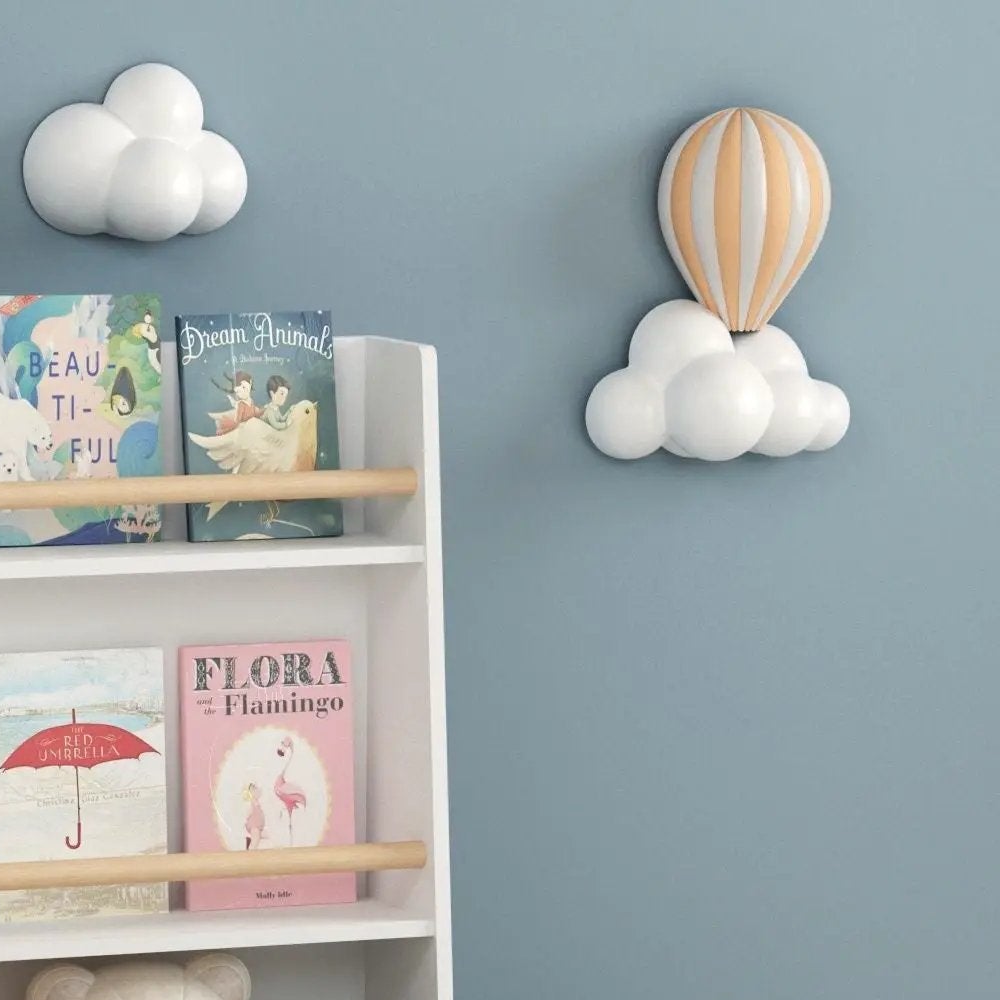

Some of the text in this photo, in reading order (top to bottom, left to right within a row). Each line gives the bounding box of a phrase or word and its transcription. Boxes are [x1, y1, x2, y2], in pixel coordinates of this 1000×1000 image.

[180, 312, 333, 366] Dream Animals
[29, 351, 116, 378] BEAU-
[52, 395, 92, 421] TI-
[71, 438, 118, 464] FUL
[192, 650, 349, 691] FLORA
[225, 692, 344, 720] Flamingo
[38, 745, 120, 762] UMBRELLA
[63, 734, 93, 748] RED
